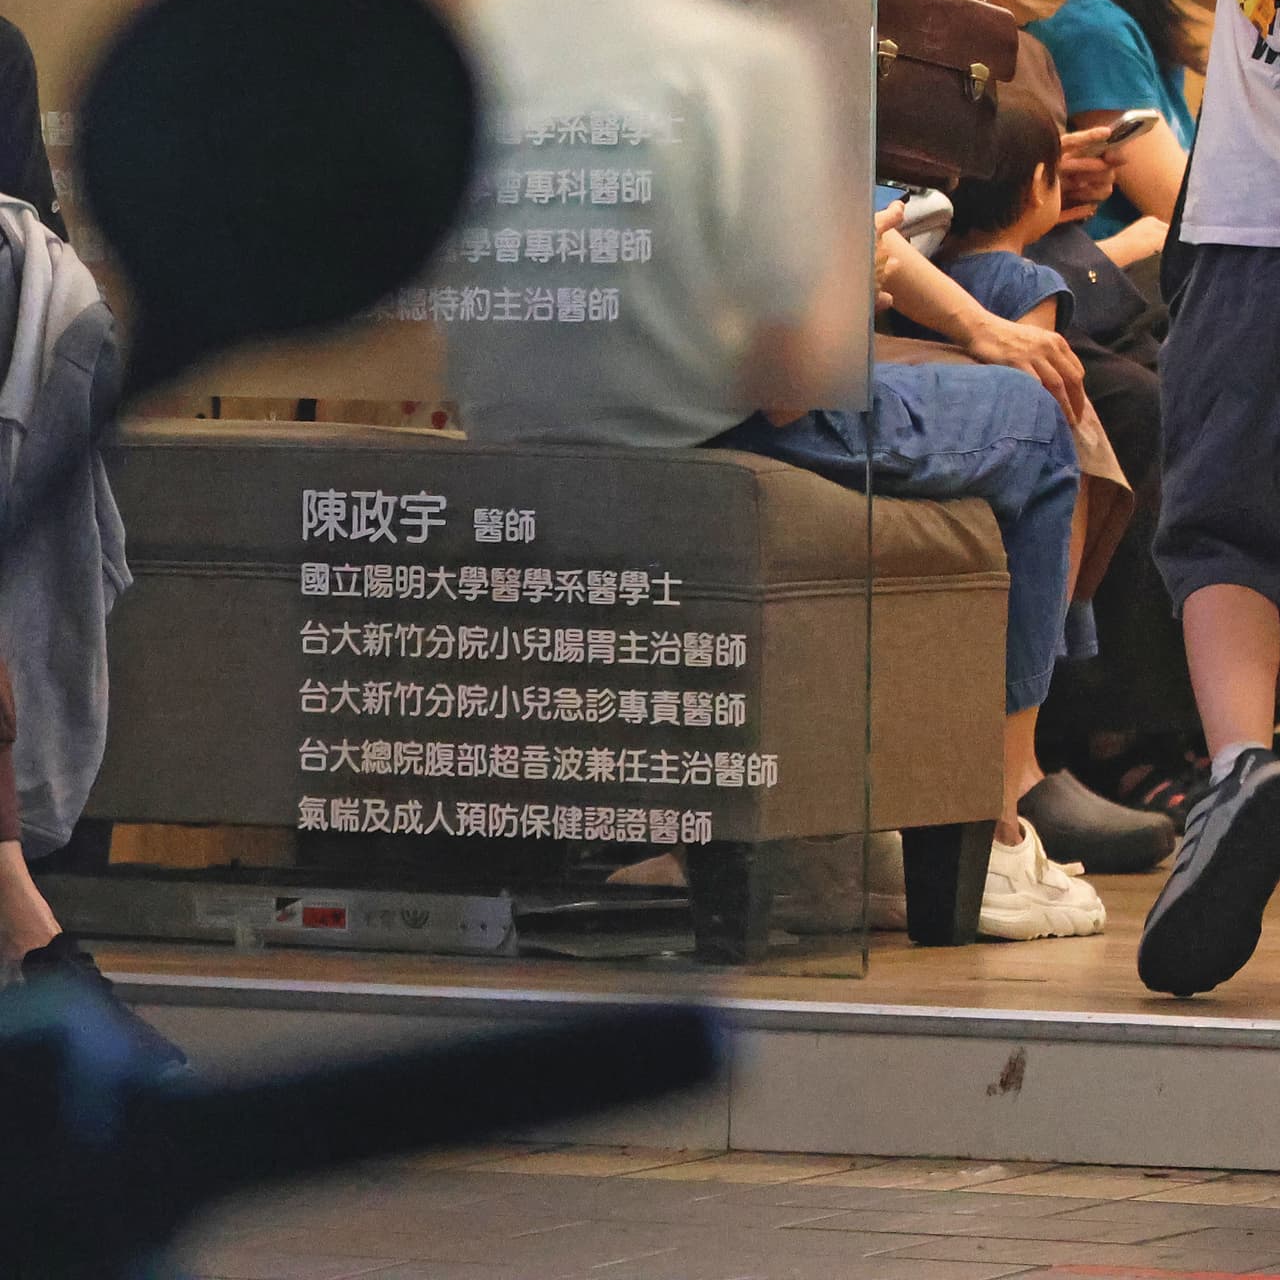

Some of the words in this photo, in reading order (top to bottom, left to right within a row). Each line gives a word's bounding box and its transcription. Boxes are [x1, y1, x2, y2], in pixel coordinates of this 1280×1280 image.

[301, 488, 447, 544] 陳政宇
[473, 508, 537, 544] 醫師
[300, 562, 683, 607] 國立陽明大學醫學系醫學士
[299, 621, 748, 668] 台大新竹分院小兒腸胃主治醫師
[299, 679, 748, 727] 台大新竹分院小兒急診專責醫師
[298, 738, 779, 789] 台大總院腹部超音波兼任主治醫師
[297, 795, 713, 846] 氣喘及成人預防保健認證醫師
